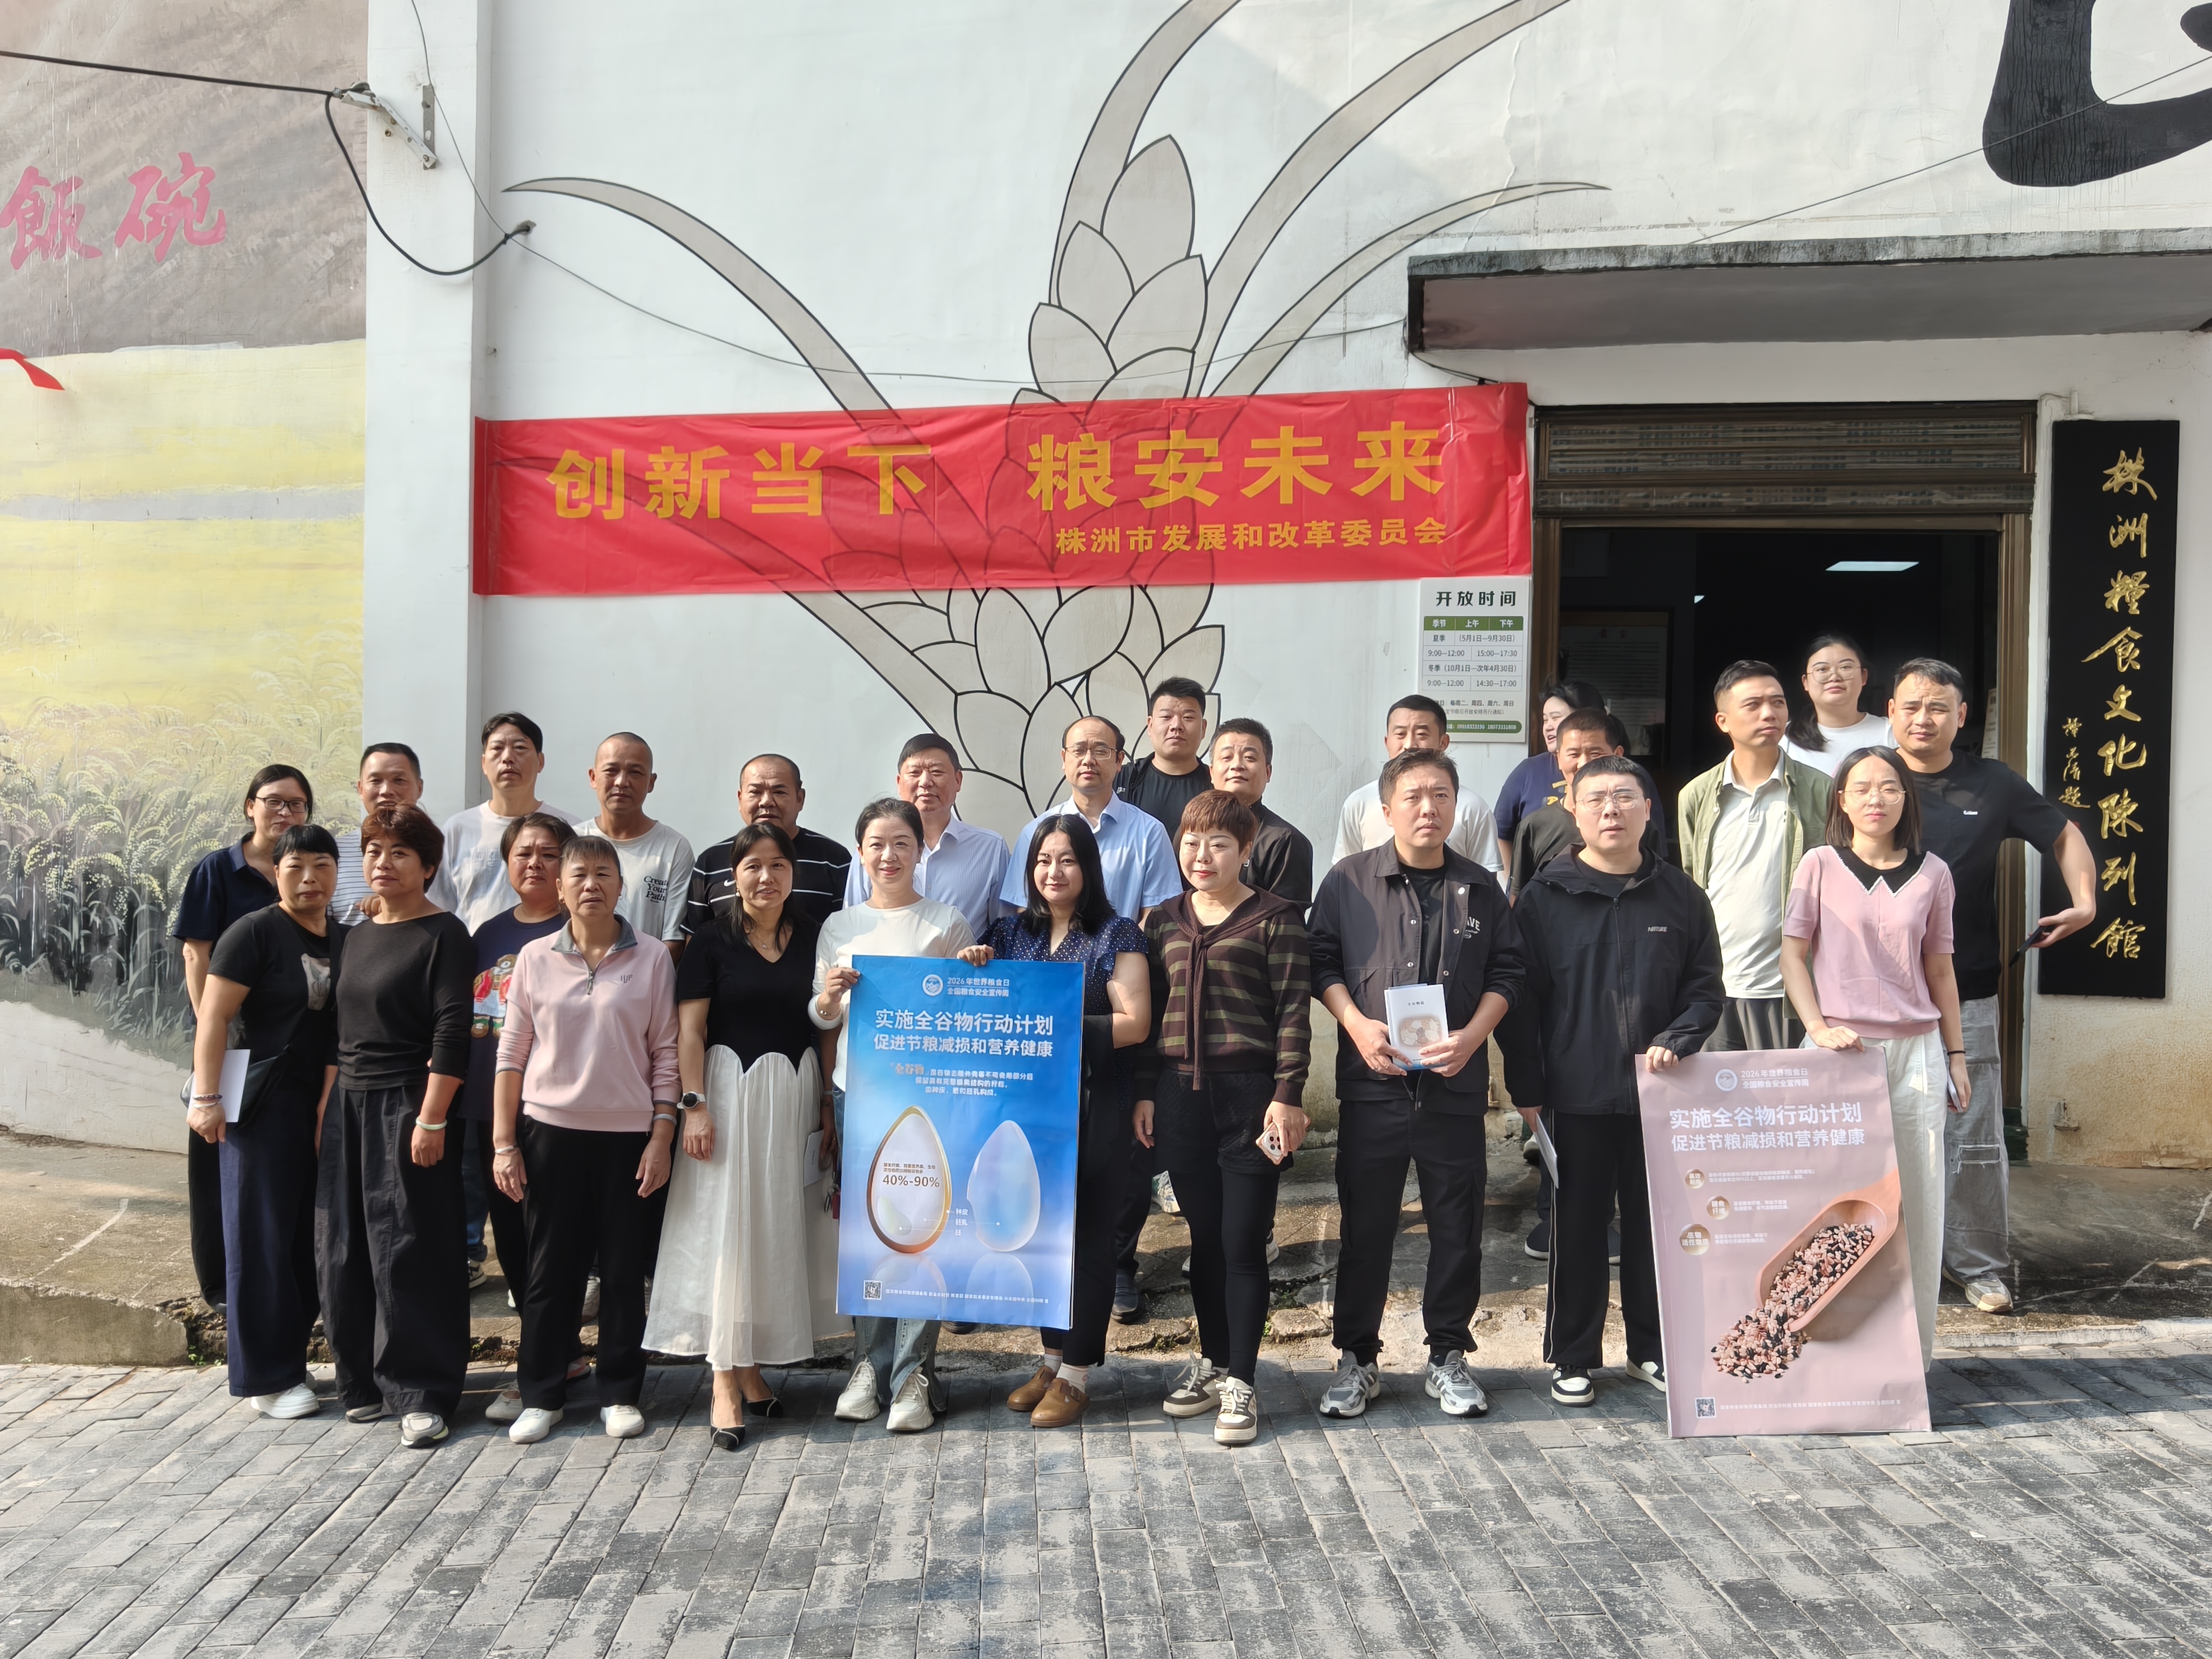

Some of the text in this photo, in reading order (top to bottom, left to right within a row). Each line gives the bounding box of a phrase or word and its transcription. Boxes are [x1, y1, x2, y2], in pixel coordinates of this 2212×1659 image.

[545, 421, 1445, 520] 创新当下 粮安未来
[1056, 517, 1447, 555] 株洲市发展和改革委员会
[1435, 591, 1516, 607] 开放时间
[1432, 619, 1513, 628] 季节 上午 下午
[648, 883, 667, 893] Your
[947, 977, 1010, 987] 2026年世界粮食日
[947, 988, 1009, 997] 全国粮食安全宣传周
[875, 1008, 1054, 1036] 实施全谷物行动计划
[874, 1033, 1053, 1057] 促进节粮减损和营养健康
[1741, 1068, 1808, 1078] 2026年世界粮食日
[1742, 1078, 1809, 1089] 全国粮食安全宣传周
[1669, 1102, 1863, 1129] 实施全谷物行动计划
[1671, 1128, 1865, 1152] 促进节粮减损和营养健康
[883, 1175, 940, 1188] 40%-90%
